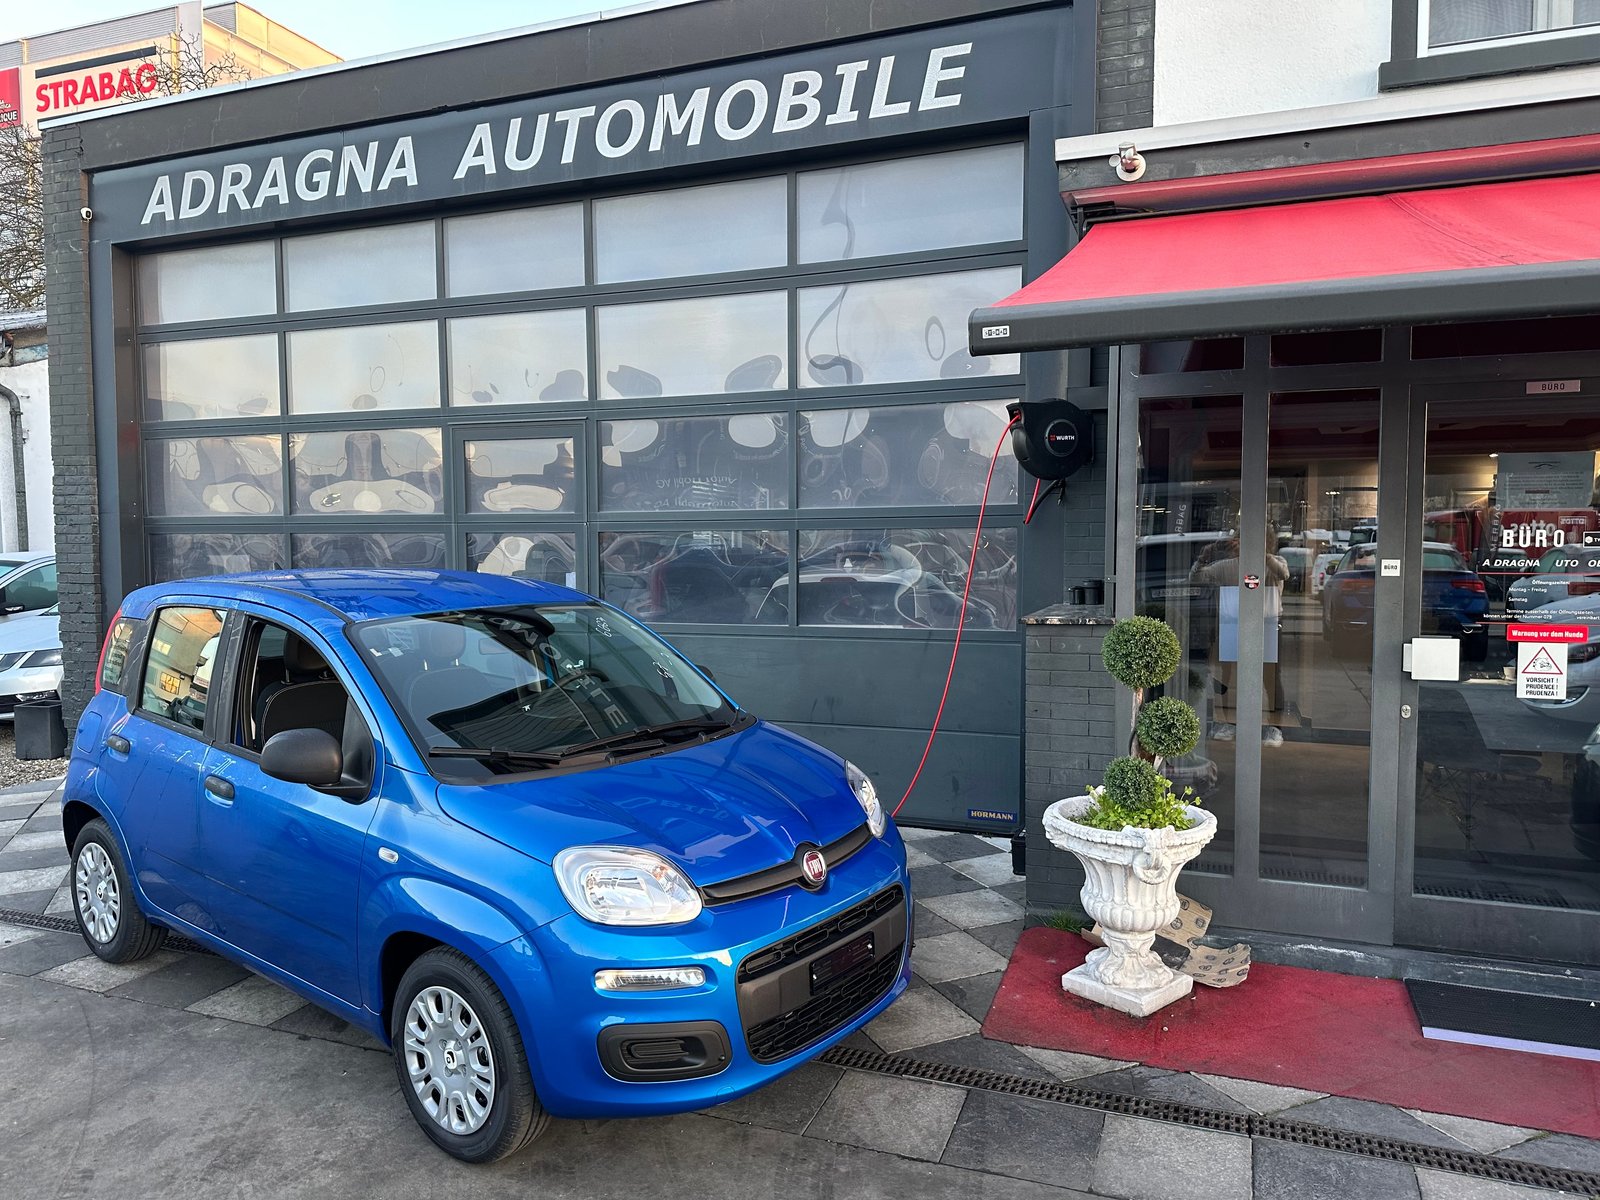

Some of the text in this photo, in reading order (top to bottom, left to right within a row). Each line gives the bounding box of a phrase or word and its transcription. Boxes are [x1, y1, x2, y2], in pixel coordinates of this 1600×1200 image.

[36, 63, 158, 113] STRABAG
[141, 42, 973, 225] ADRAGNA AUTOMOBILE
[1502, 526, 1565, 548] BÜRO
[1512, 629, 1538, 638] Warnung
[808, 858, 822, 875] FIAT
